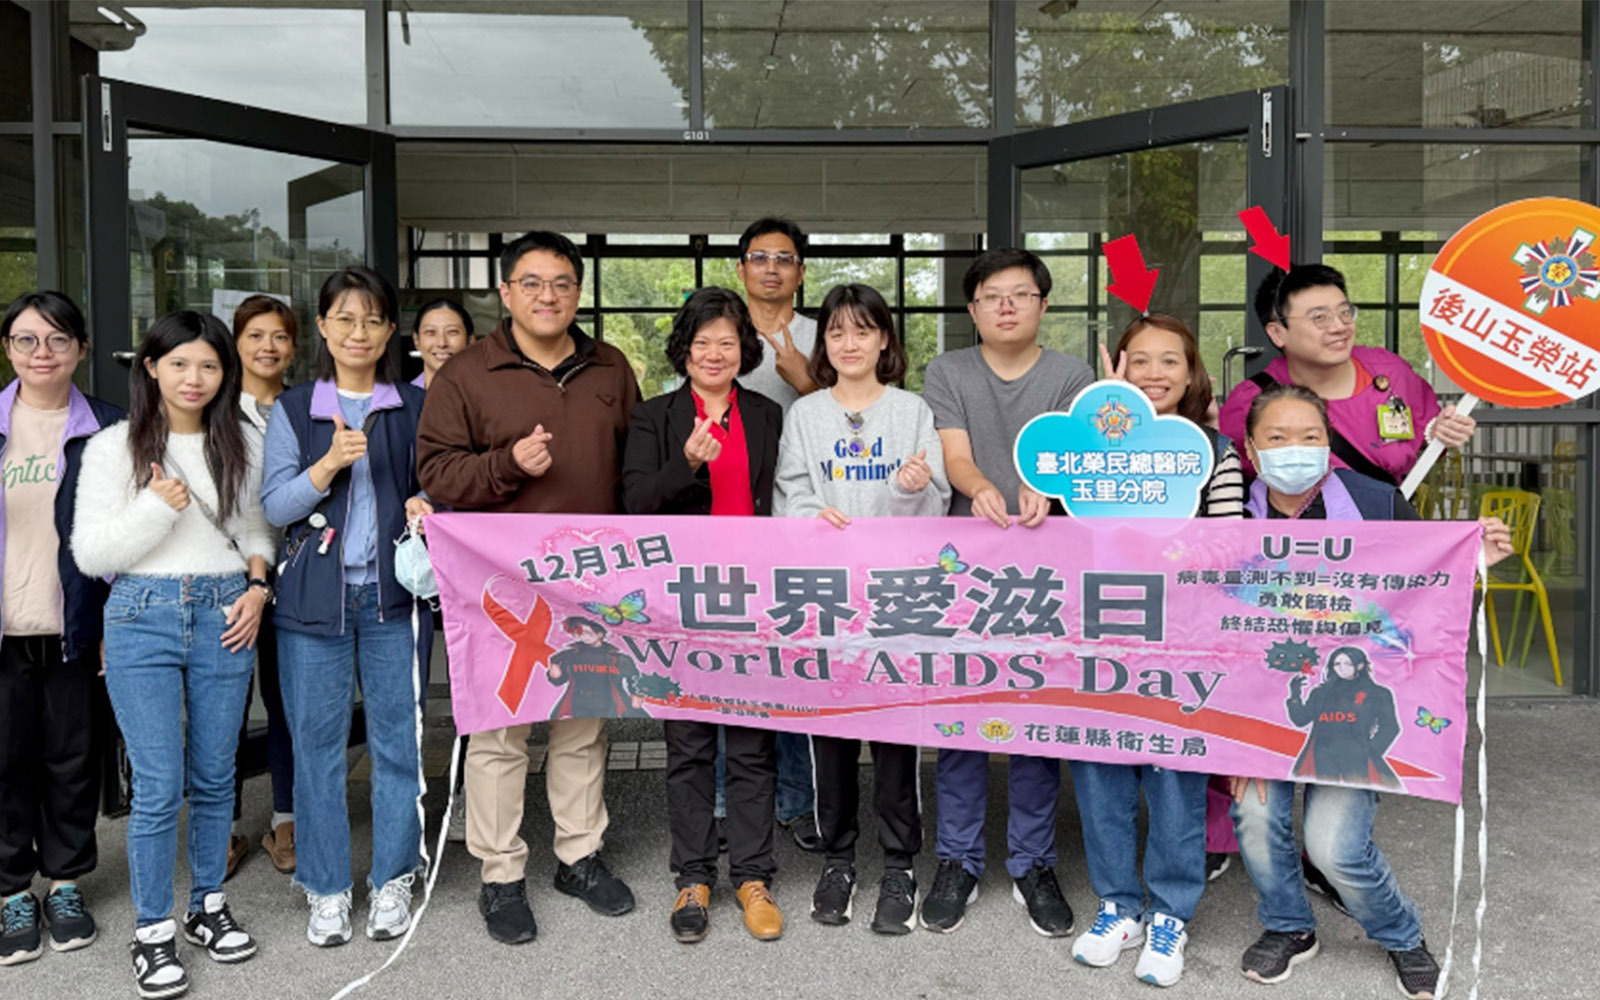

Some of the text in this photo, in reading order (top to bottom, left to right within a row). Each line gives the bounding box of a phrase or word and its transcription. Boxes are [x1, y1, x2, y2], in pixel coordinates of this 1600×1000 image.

[683, 131, 710, 140] G101
[1429, 288, 1597, 390] 後山玉榮站
[1035, 451, 1201, 475] 臺北榮民總醫院
[1071, 479, 1167, 503] 玉里分院
[519, 534, 674, 584] 12月1日
[1262, 536, 1353, 561] U=U
[666, 564, 1165, 642] 世界愛滋日
[1258, 591, 1353, 612] 勇敢篩檢
[1220, 615, 1384, 636] 終結恐懼與偏見
[621, 636, 1227, 714] World AIDS Day
[1318, 711, 1357, 723] AIDS
[1024, 723, 1207, 756] 花蓮縣衛生局
